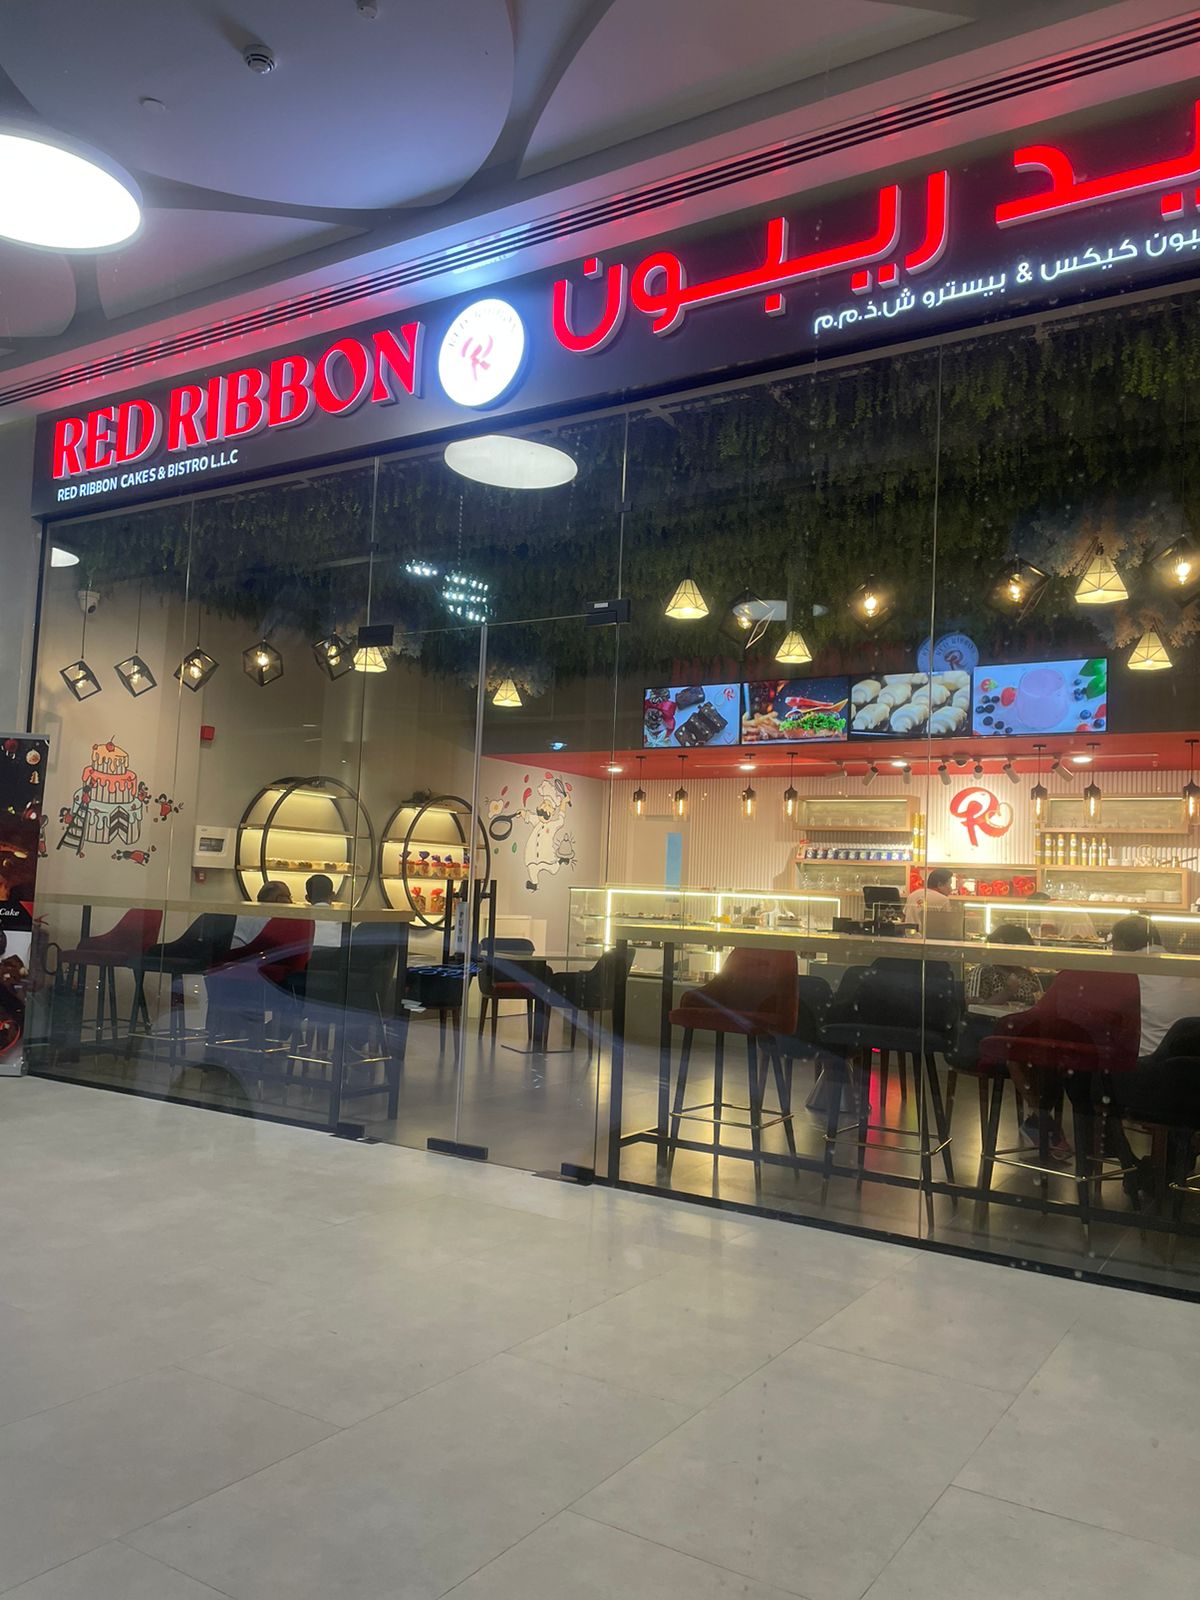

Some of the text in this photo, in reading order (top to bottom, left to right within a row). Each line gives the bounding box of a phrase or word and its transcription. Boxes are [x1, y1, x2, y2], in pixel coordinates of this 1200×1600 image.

[552, 170, 950, 353] ريبون
[1016, 262, 1033, 283] &
[1040, 239, 1138, 281] كيكس
[922, 273, 1006, 308] بيسترو
[53, 321, 422, 479] RED RIBBON
[57, 449, 239, 501] RED RIBBON CAKES & BISTRO L.L.C
[0, 908, 20, 917] Cake
